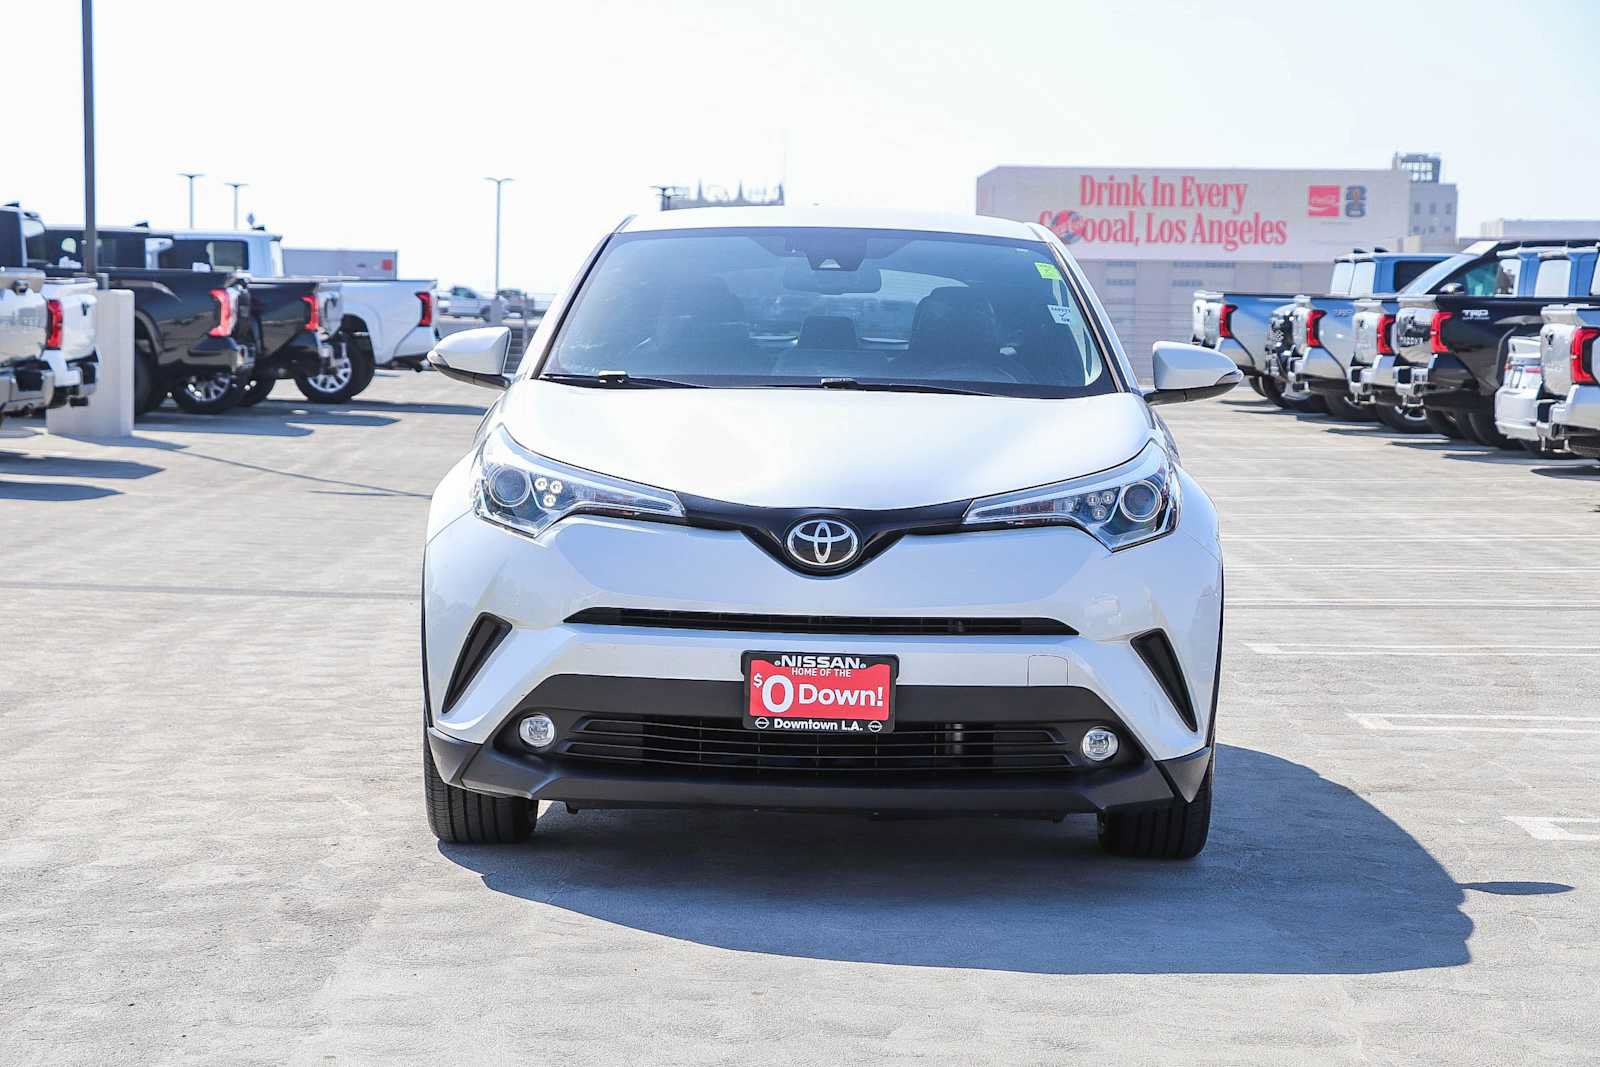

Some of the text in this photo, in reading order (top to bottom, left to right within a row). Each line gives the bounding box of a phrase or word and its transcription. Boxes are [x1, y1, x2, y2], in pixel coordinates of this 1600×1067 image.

[1080, 174, 1248, 215] Drink In Every
[1146, 212, 1187, 244] Los
[1191, 211, 1287, 252] Angeles
[781, 655, 860, 669] NISSAN
[791, 667, 851, 678] HOME OF THE
[798, 683, 884, 707] Down!
[774, 718, 838, 731] Downtown
[841, 720, 863, 731] L.A.
